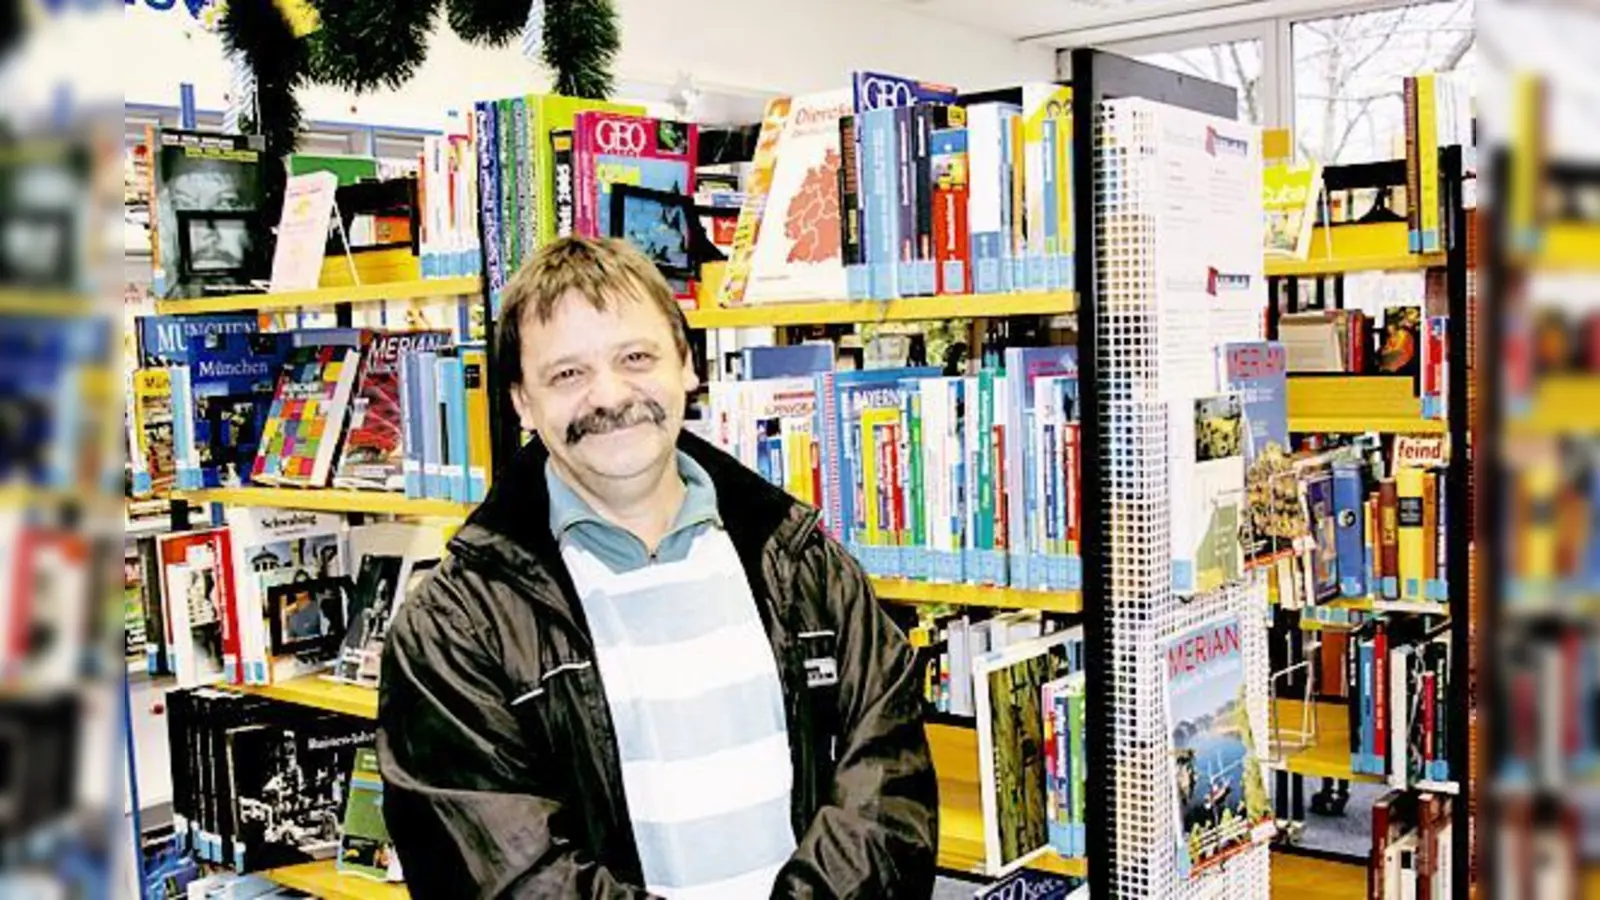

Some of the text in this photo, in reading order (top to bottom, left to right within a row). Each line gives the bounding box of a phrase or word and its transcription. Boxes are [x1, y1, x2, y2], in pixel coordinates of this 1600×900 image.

[595, 120, 646, 150] GEO
[199, 357, 269, 377] München
[1399, 439, 1441, 459] feind
[1168, 624, 1240, 681] MERIAN
